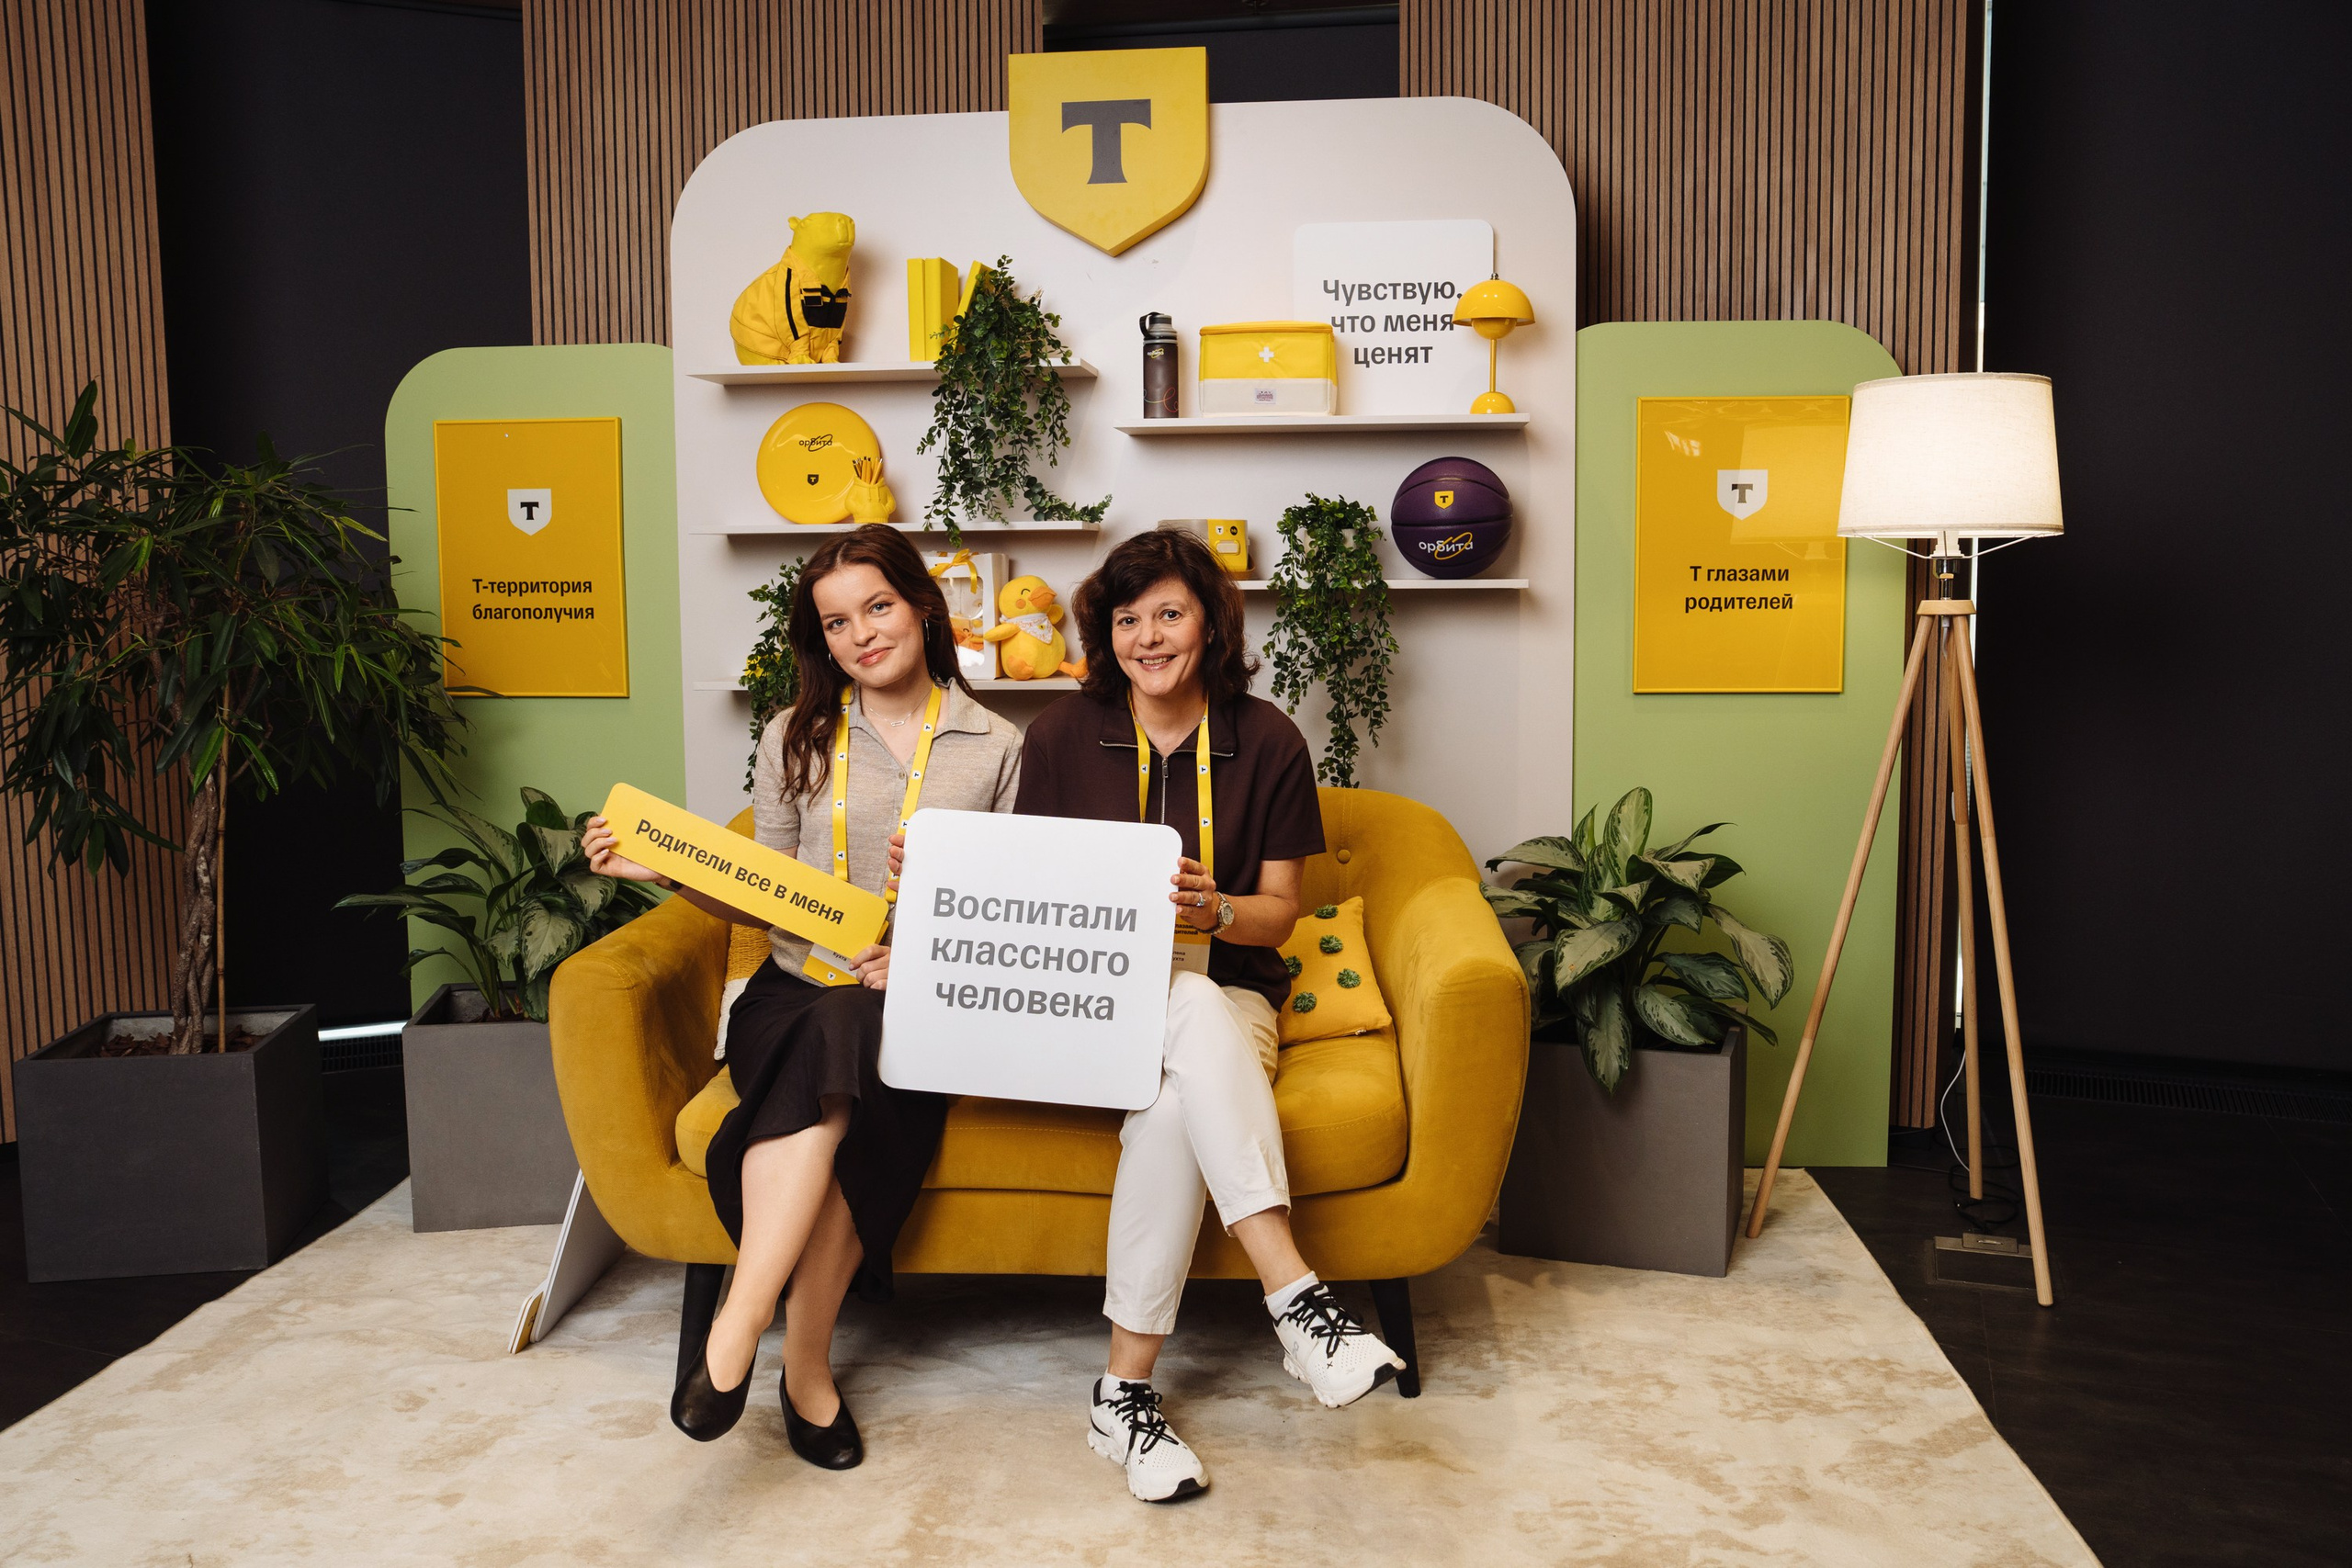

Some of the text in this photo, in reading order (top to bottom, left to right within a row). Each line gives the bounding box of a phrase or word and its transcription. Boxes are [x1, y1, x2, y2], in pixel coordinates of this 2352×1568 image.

[1062, 99, 1152, 185] Т
[1330, 313, 1454, 333] что меня
[1353, 345, 1433, 368] ценят
[798, 436, 833, 449] орбита
[1440, 495, 1449, 503] Т
[1731, 483, 1754, 504] Т
[520, 501, 539, 521] Т
[1419, 536, 1474, 556] орбита
[1690, 566, 1790, 582] Т глазами
[472, 578, 593, 597] Т-территория
[472, 604, 595, 623] благополучия
[1684, 593, 1793, 614] родителей
[635, 818, 844, 925] Родители все в меня
[933, 887, 1137, 932] Воспитали
[931, 937, 1130, 976] классного
[935, 982, 1115, 1021] человека
